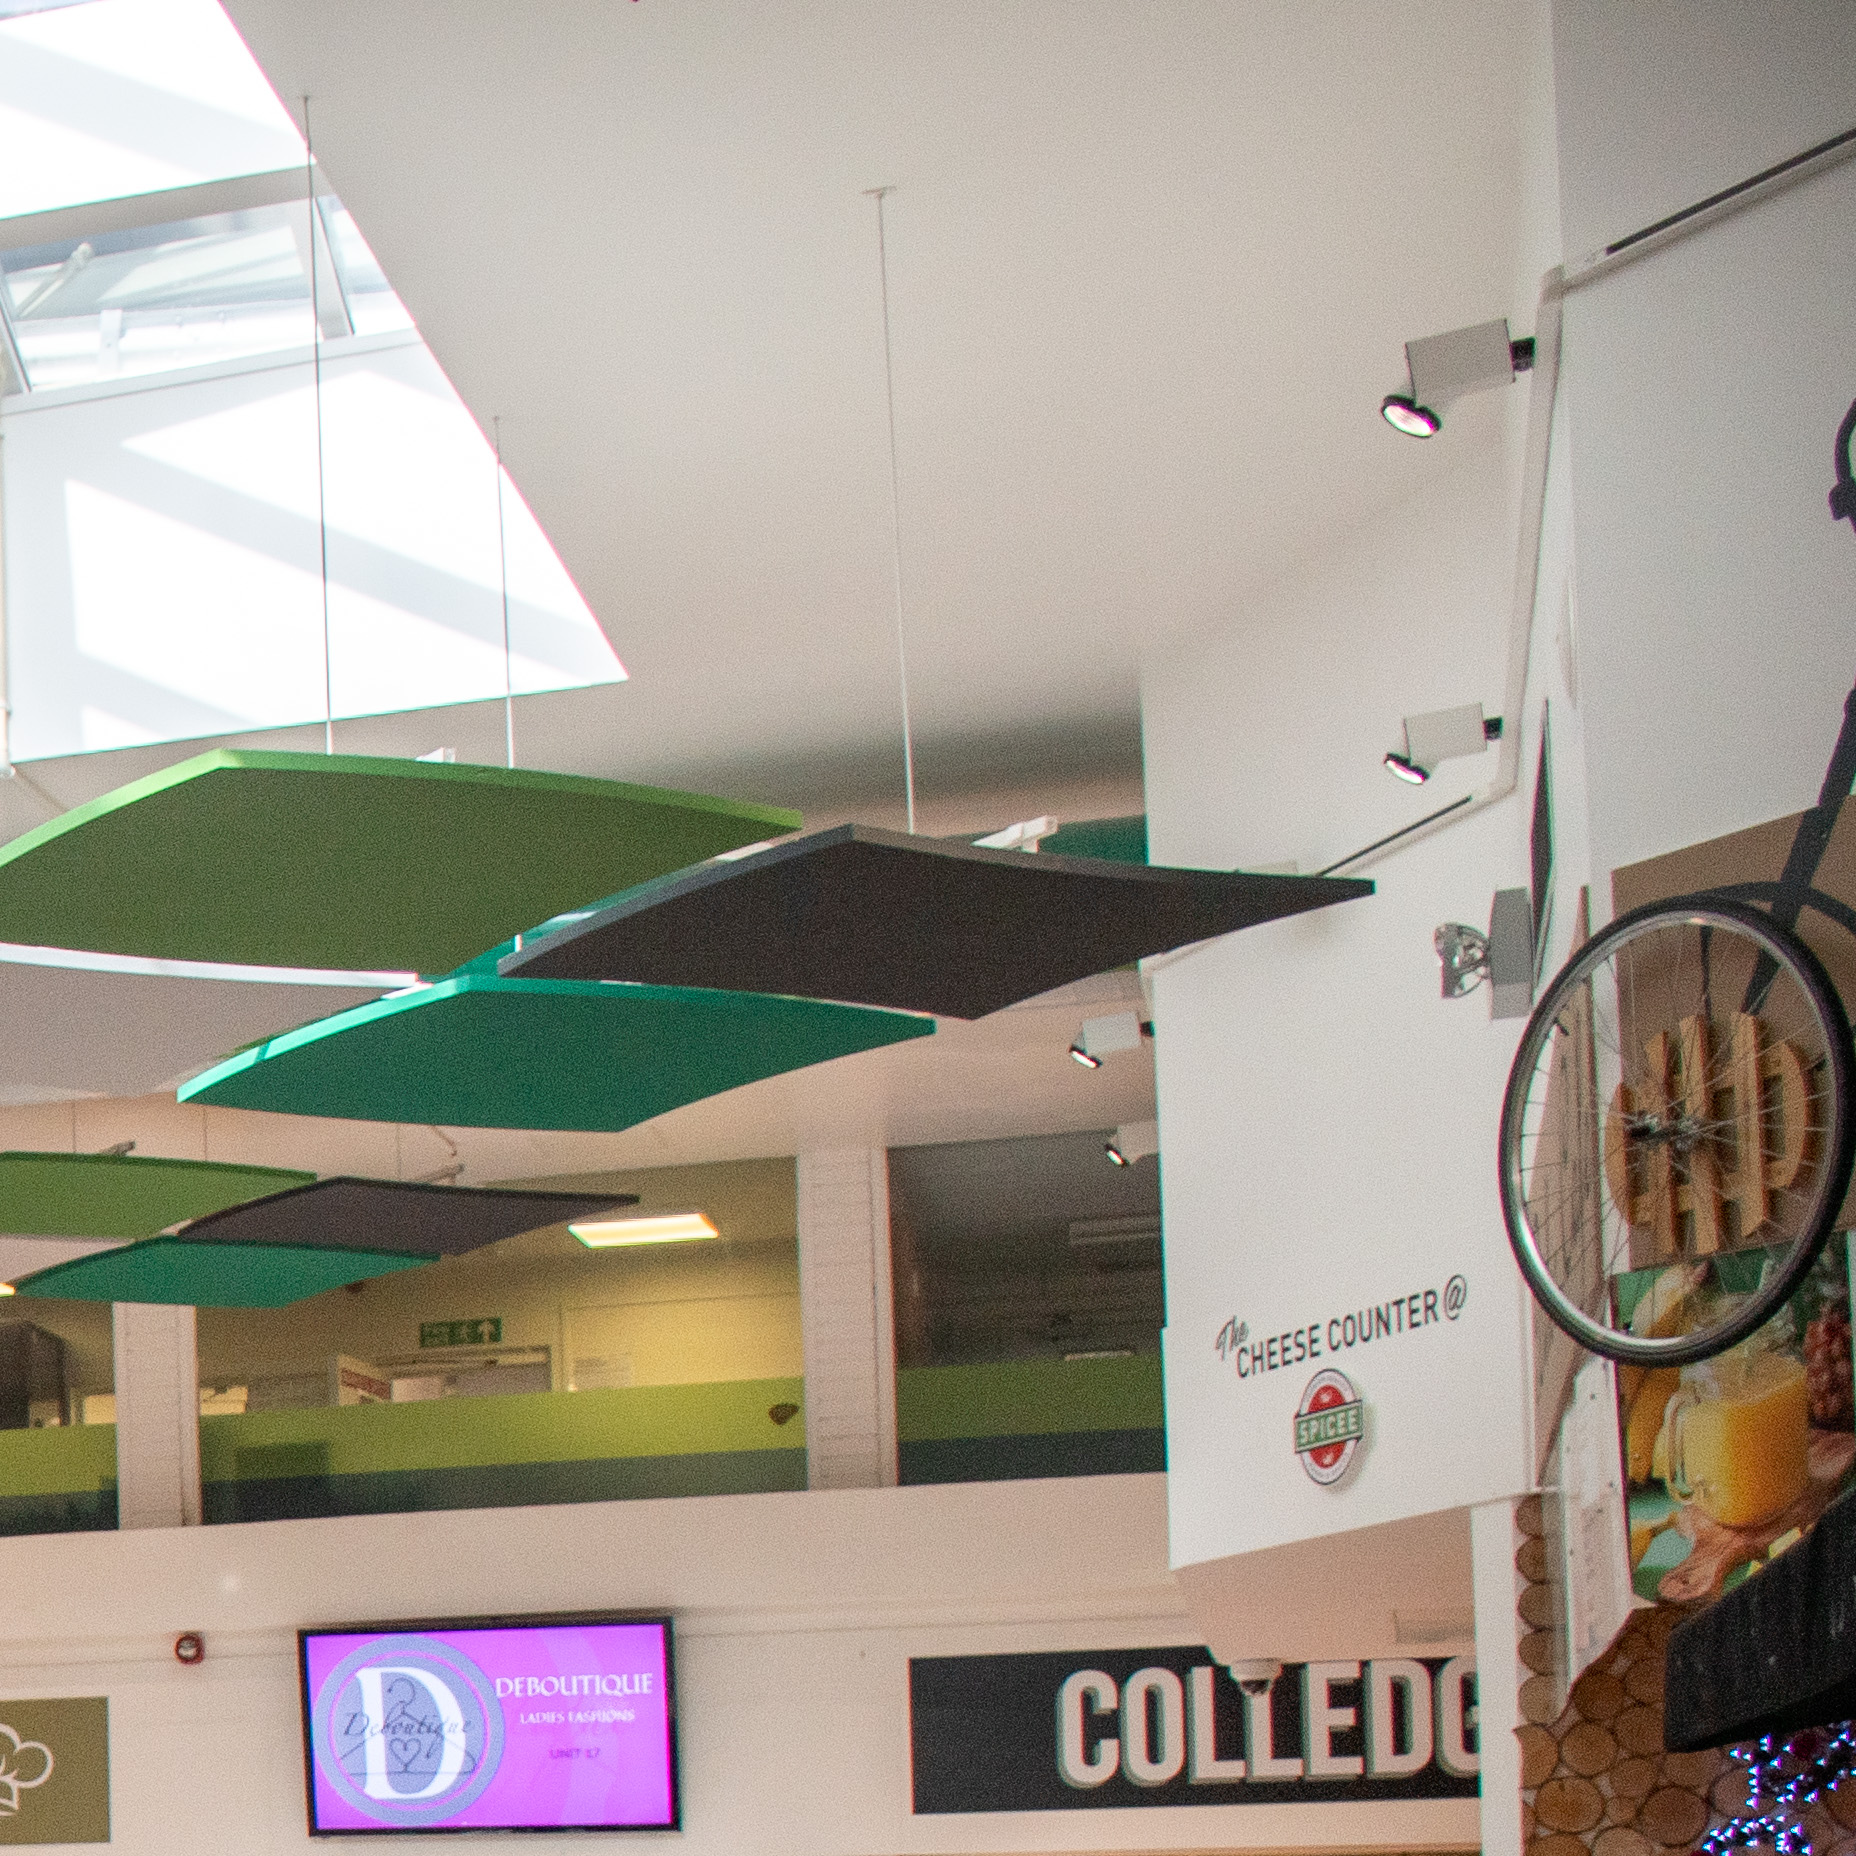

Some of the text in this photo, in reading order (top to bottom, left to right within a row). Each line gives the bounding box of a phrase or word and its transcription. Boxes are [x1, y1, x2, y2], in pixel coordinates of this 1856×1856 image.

[1215, 1274, 1468, 1378] The CHEESE COUNTER @
[1298, 1408, 1359, 1445] SPICEE
[495, 1673, 654, 1699] DEBOUTIQUE
